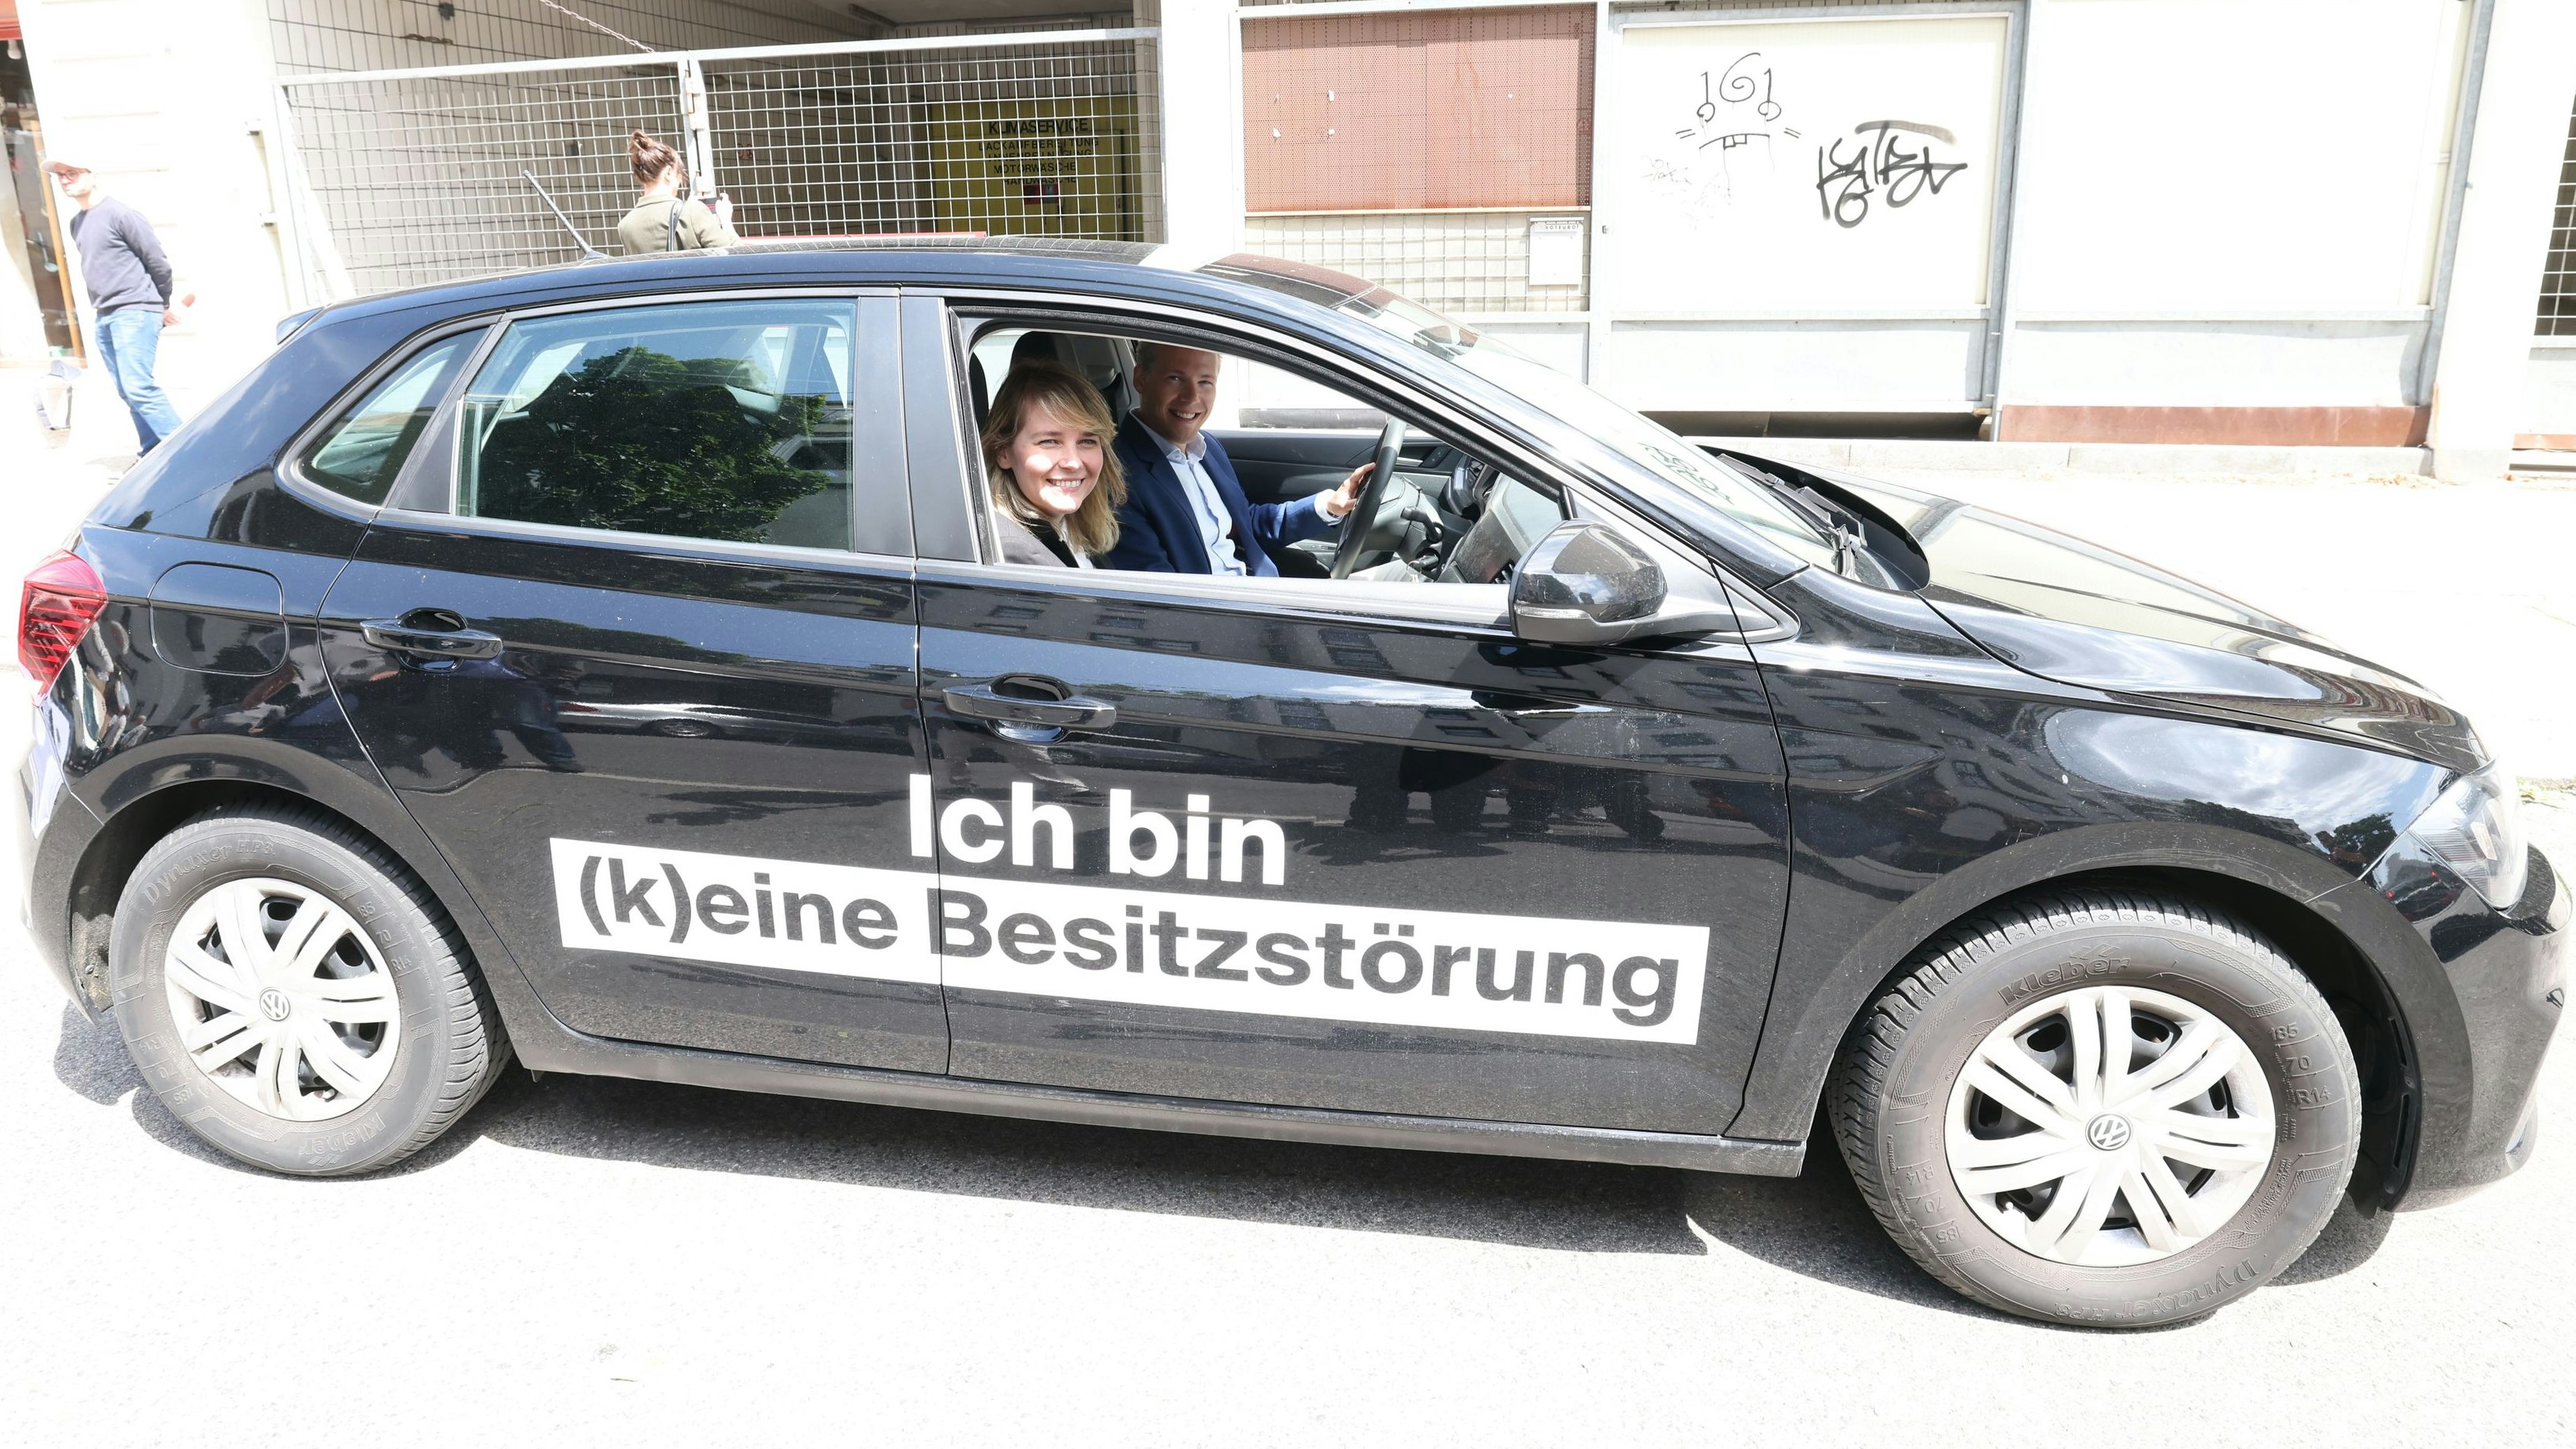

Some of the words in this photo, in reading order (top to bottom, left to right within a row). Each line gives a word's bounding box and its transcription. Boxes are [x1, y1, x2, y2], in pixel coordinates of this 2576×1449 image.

[989, 118, 1089, 135] KLIMASERVICE
[979, 137, 1099, 151] LACKAUFBEREITUNG
[988, 149, 1092, 162] INNENREINGUNG
[909, 773, 1075, 870] Ich
[1110, 788, 1286, 886] bin
[141, 844, 233, 907] Dynaxer
[376, 929, 392, 945] 70
[390, 955, 412, 972] R14
[579, 855, 898, 950] (k)eine
[926, 887, 1680, 1028] Besitzstörung
[1997, 957, 2132, 1006] Kleber
[2268, 1021, 2299, 1042] 185
[2285, 1055, 2313, 1072] 70
[2295, 1085, 2332, 1105] R14
[298, 1112, 386, 1157] Kleber
[1906, 1164, 1936, 1186] R14
[1925, 1195, 1946, 1215] 70
[1935, 1225, 1961, 1245] 185
[2114, 1257, 2259, 1320] Dynaxer
